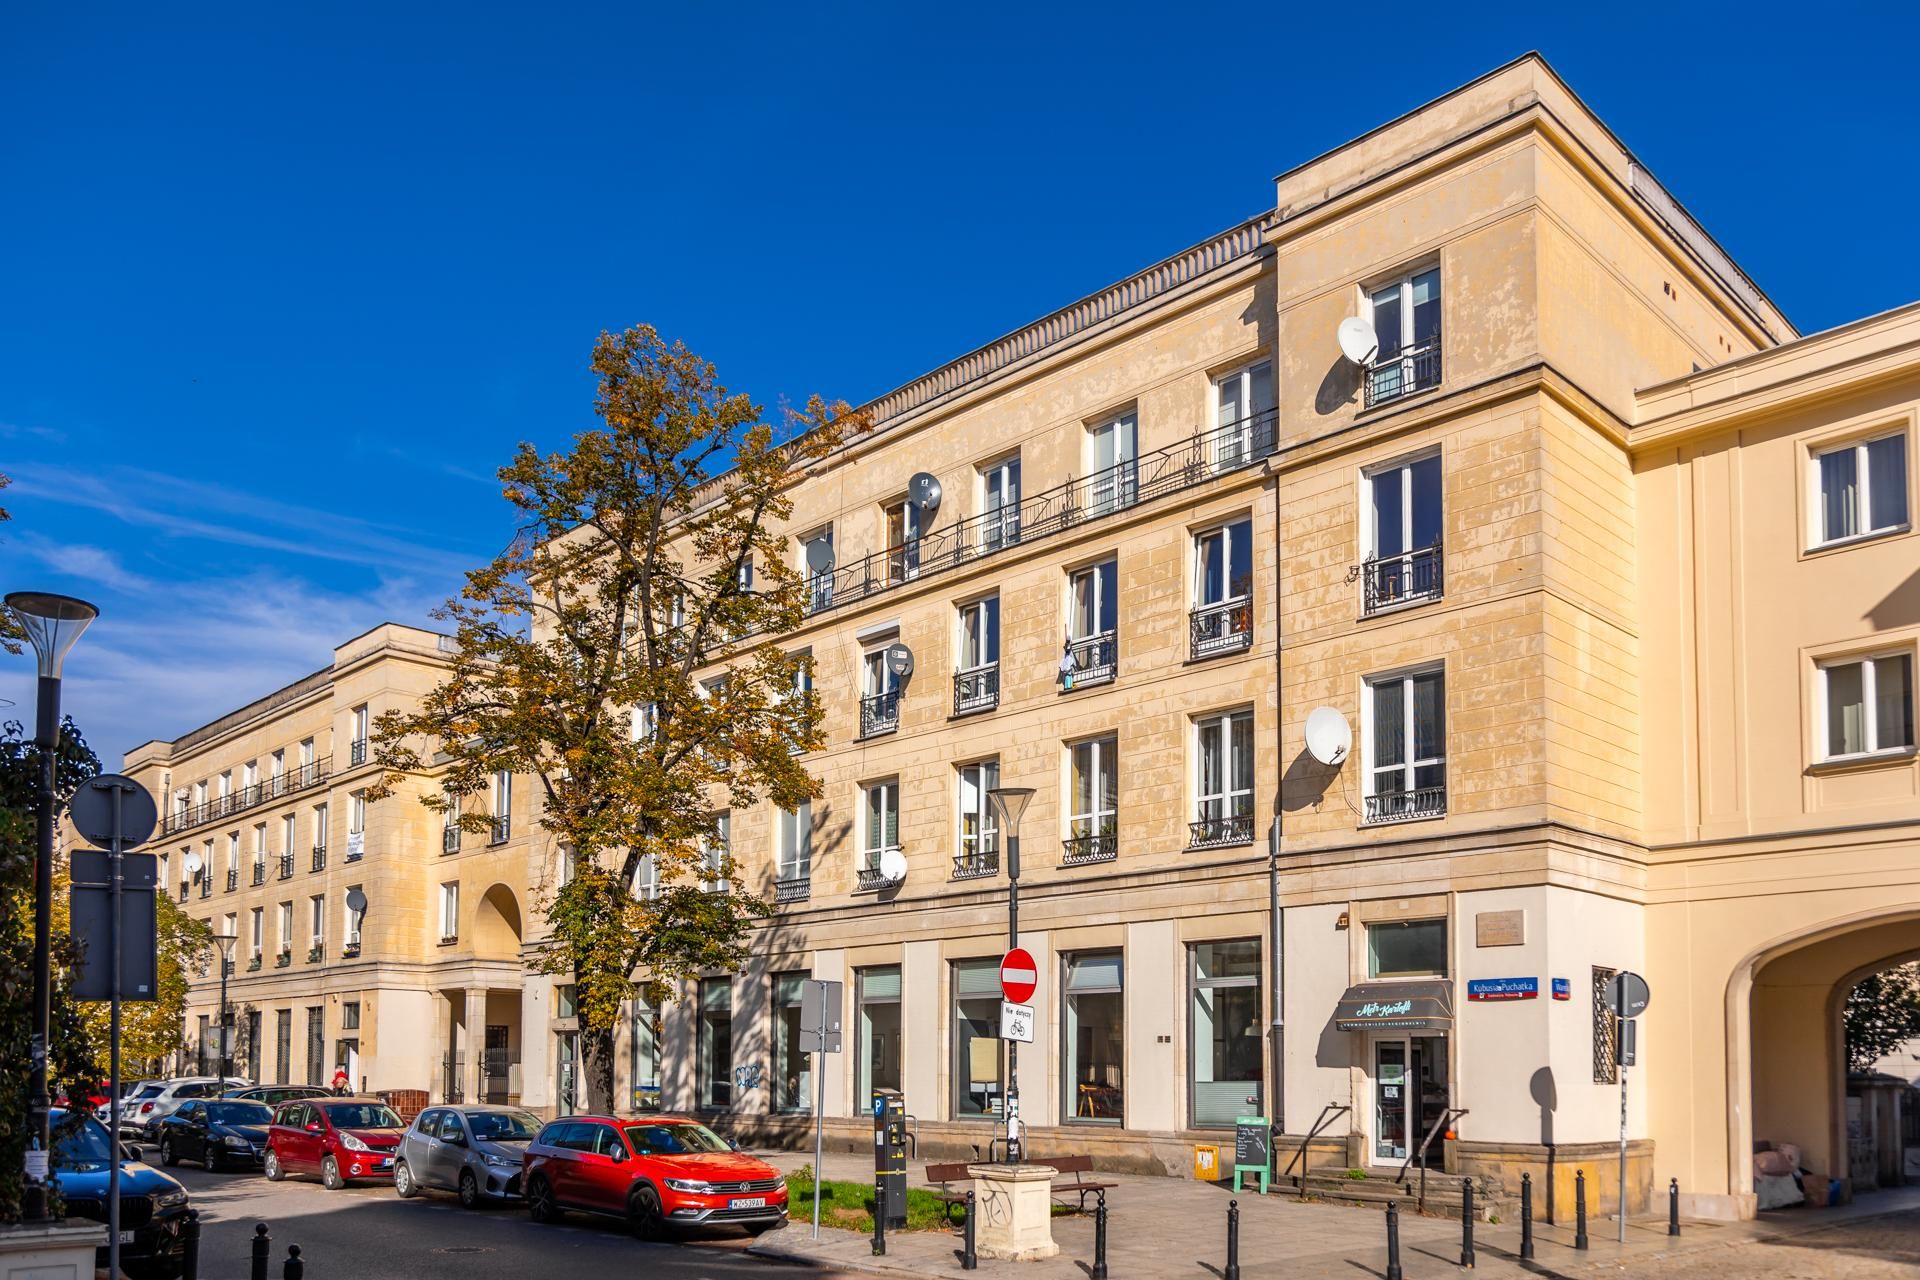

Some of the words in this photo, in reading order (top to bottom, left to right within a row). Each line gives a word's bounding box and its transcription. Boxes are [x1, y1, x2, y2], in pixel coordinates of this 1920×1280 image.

[1473, 984, 1499, 993] Kubusia
[1501, 982, 1533, 991] Puchatka
[1005, 1006, 1013, 1014] Nie
[1015, 1009, 1031, 1020] dotyczy
[875, 1099, 882, 1113] P
